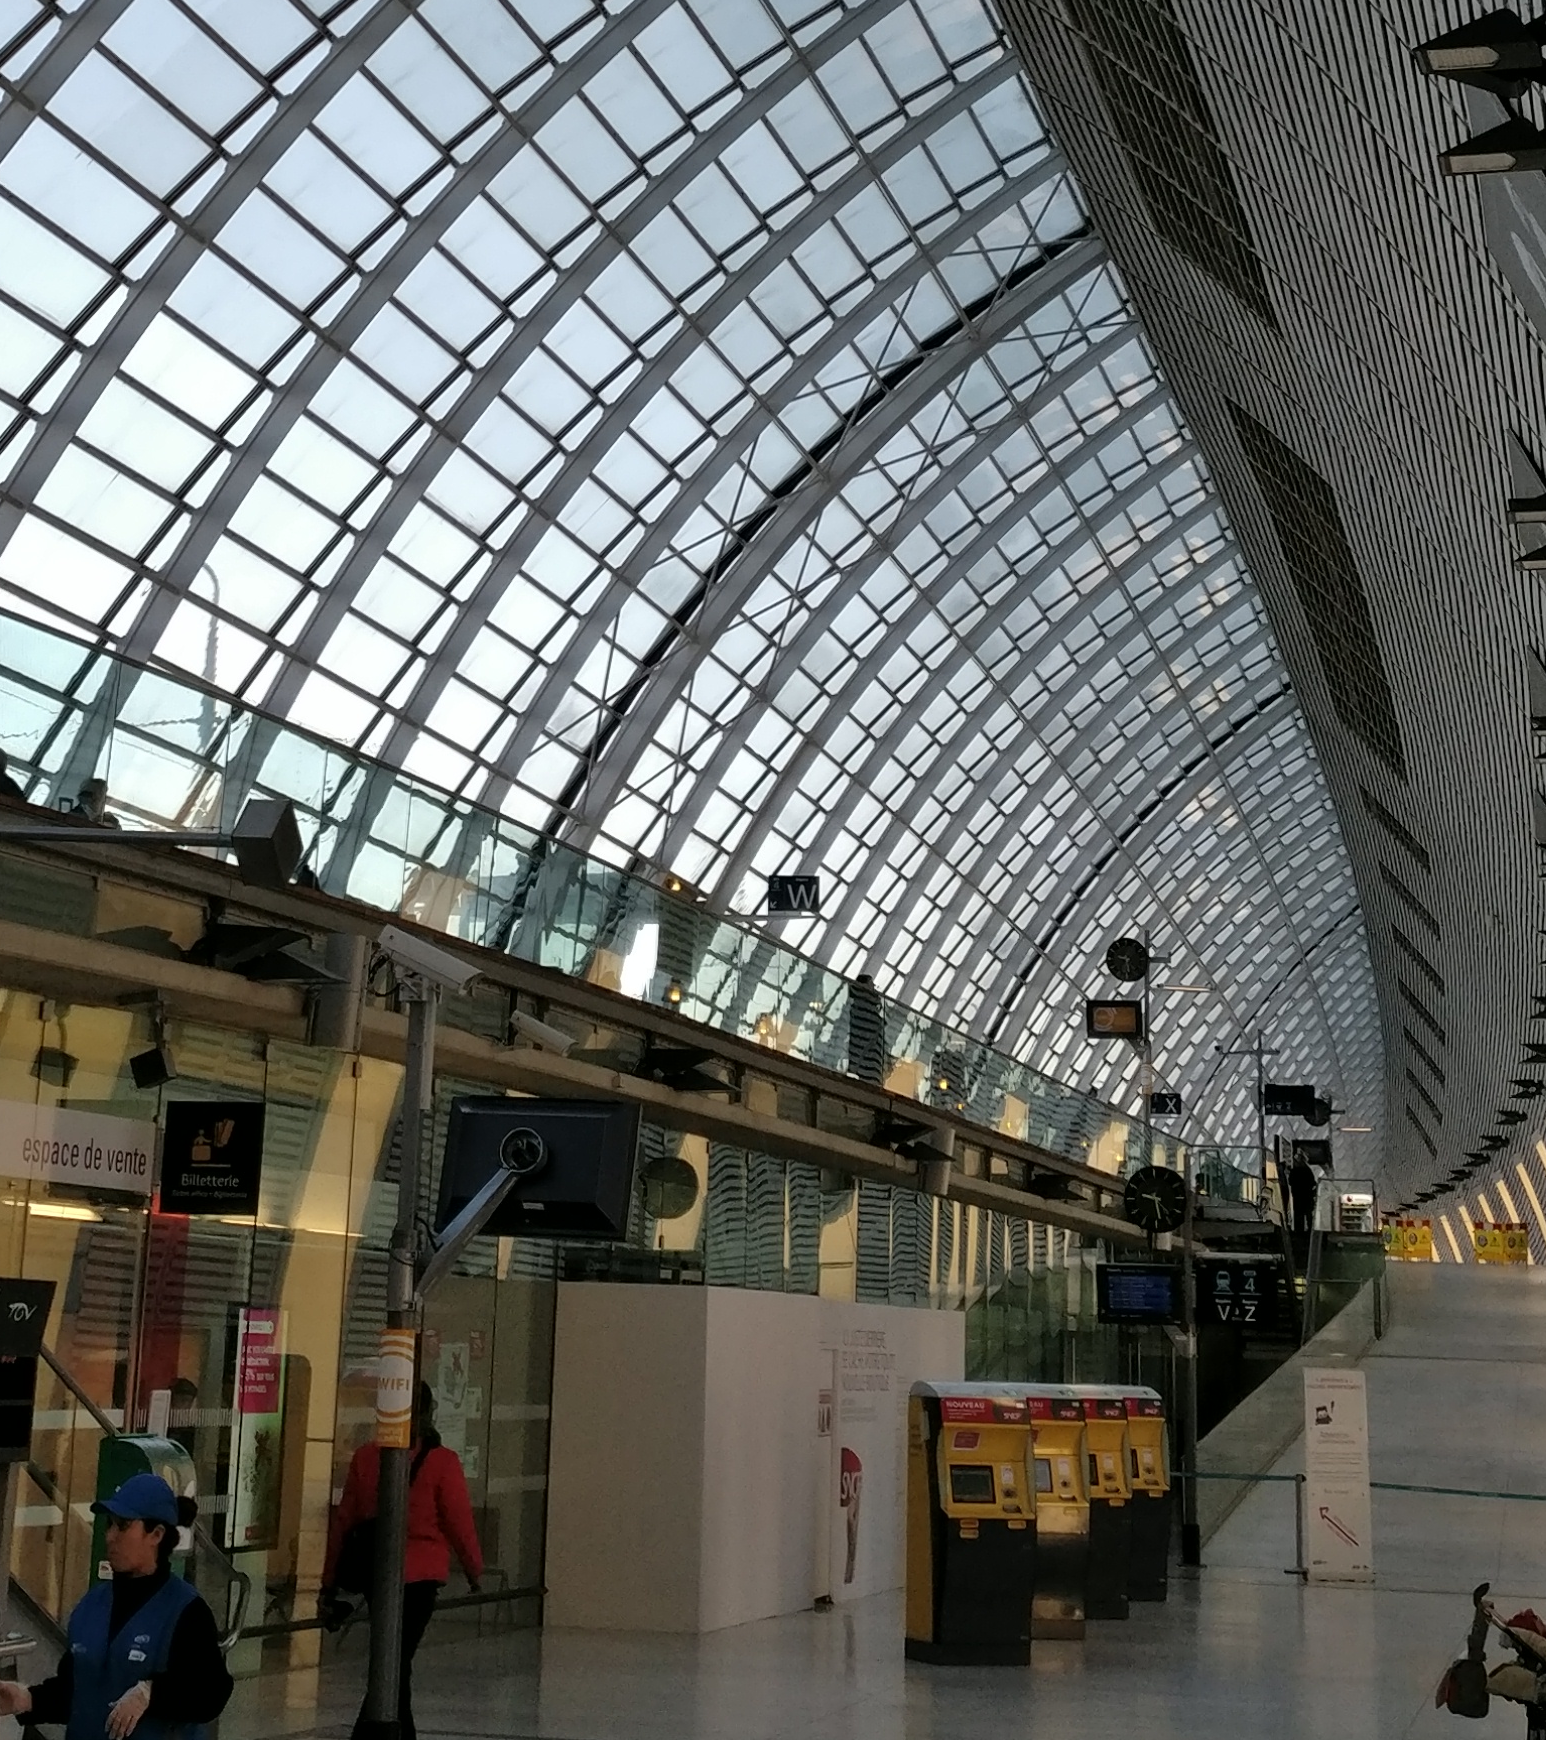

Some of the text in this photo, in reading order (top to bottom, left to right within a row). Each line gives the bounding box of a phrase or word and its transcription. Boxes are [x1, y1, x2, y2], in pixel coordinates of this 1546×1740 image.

[787, 884, 817, 909] W
[1165, 1098, 1177, 1113] X
[23, 1137, 147, 1176] espace de vente
[181, 1173, 240, 1187] Billetterie
[1244, 1278, 1256, 1292] 4
[1217, 1305, 1256, 1321] V Z
[379, 1377, 410, 1391] WIFI
[946, 1401, 985, 1409] NOUVEAU
